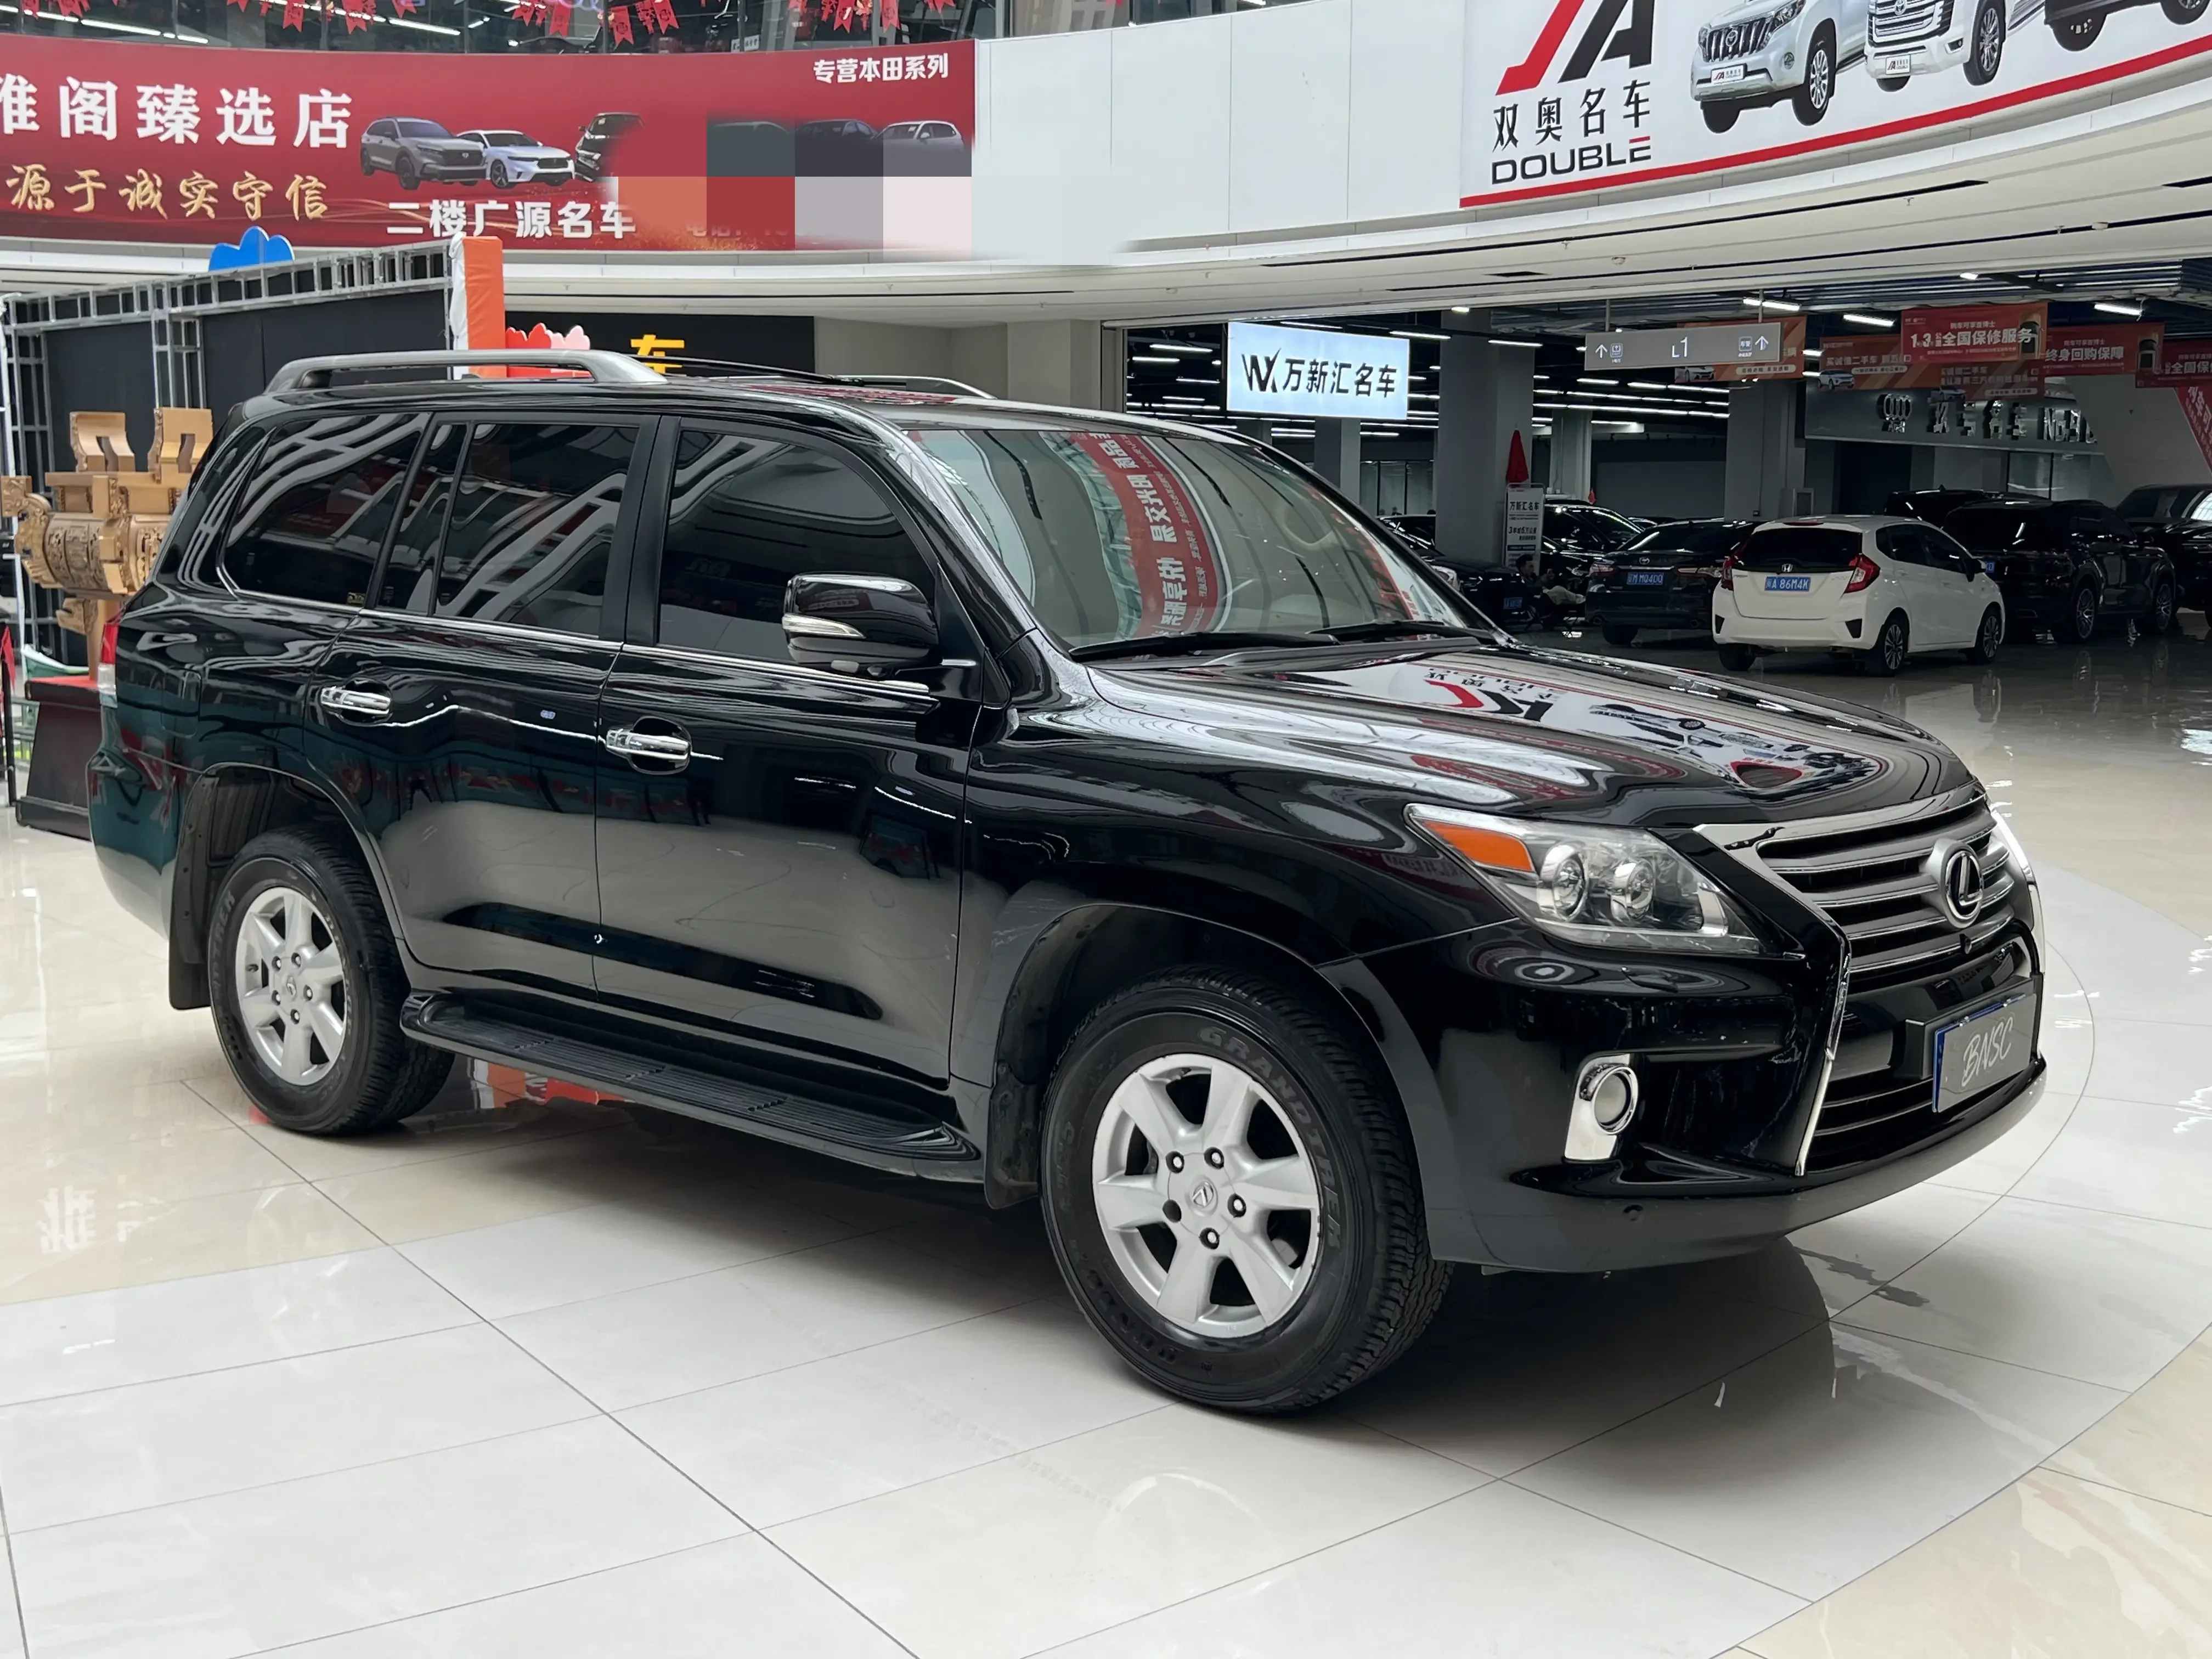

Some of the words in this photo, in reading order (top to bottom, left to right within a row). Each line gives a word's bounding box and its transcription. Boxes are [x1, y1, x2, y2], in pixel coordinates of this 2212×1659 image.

[813, 53, 949, 84] 专营本田系列
[1492, 80, 1651, 153] 双奥名车
[1491, 136, 1652, 185] DOUBLE
[5, 163, 329, 221] 源于诚实守信
[386, 199, 636, 239] 二楼广源名车
[1671, 336, 1688, 358] L1
[2045, 346, 2124, 362] 终身回购保障
[1282, 358, 1398, 398] 万新汇名车
